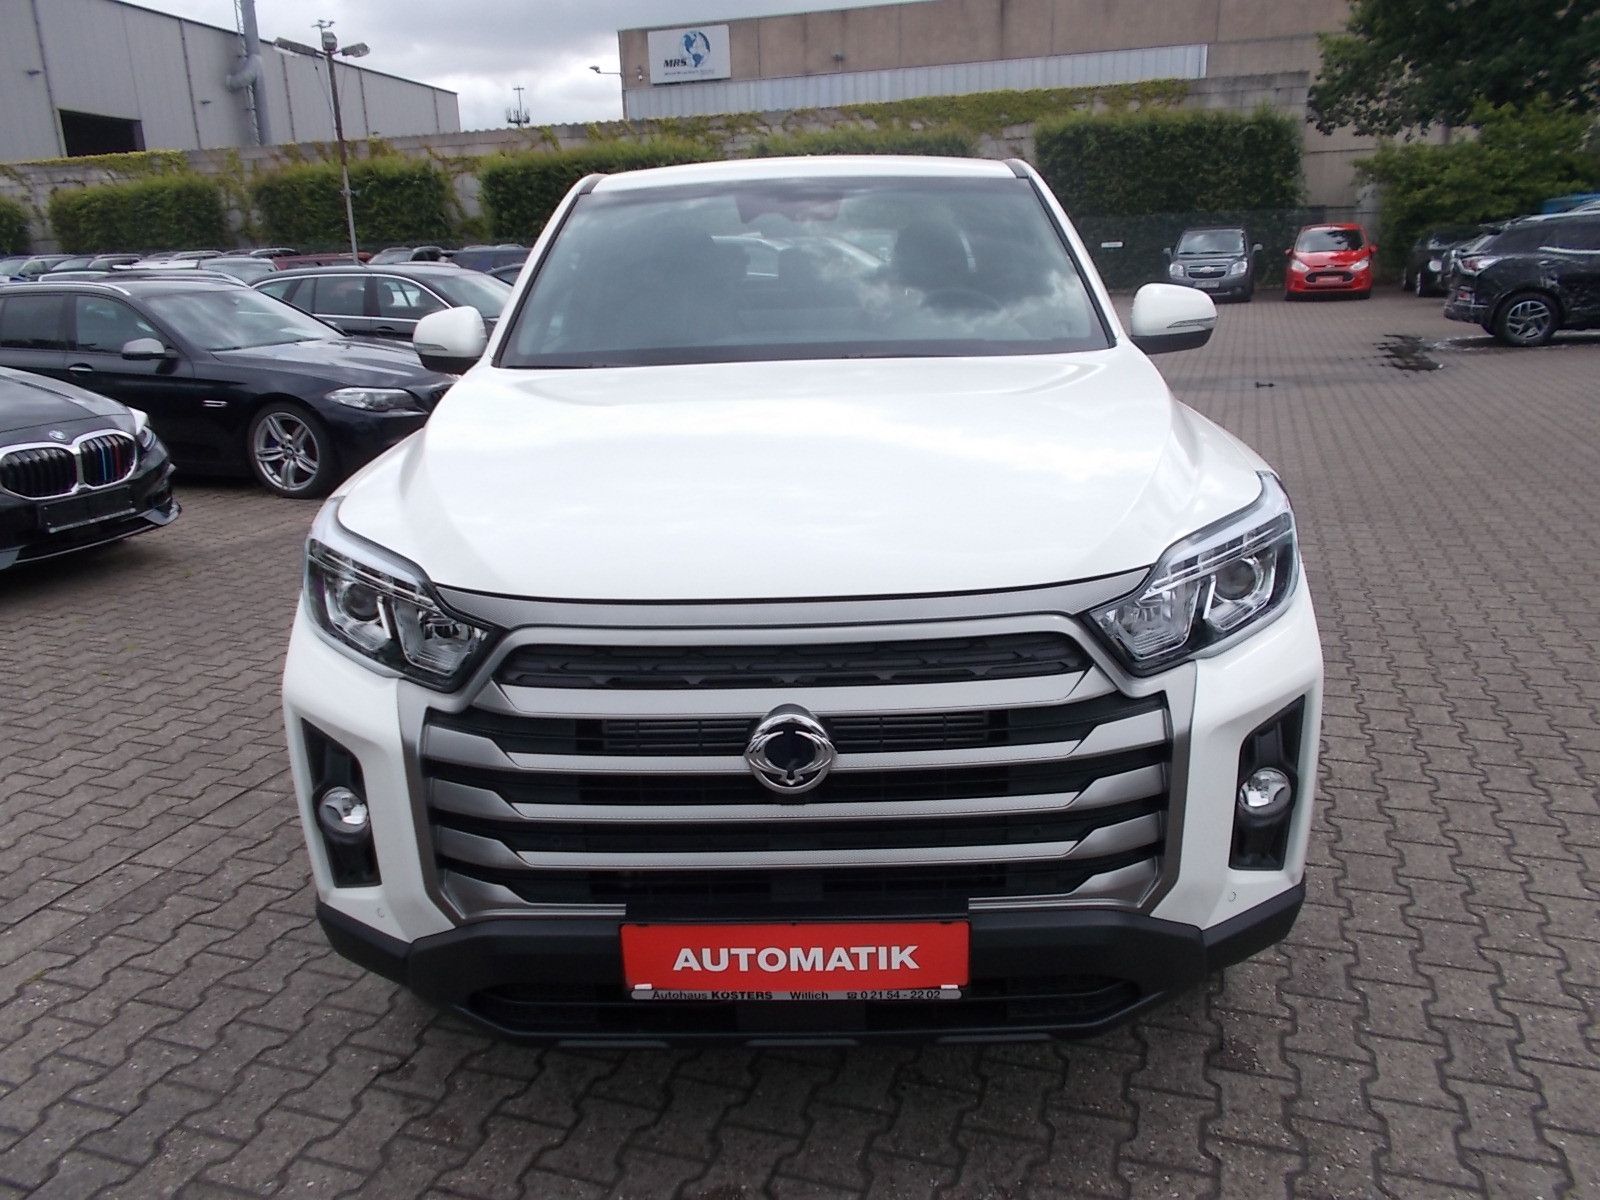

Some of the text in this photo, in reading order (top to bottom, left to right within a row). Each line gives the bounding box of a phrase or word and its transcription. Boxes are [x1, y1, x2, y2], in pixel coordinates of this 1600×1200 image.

[664, 58, 687, 68] MRS
[673, 946, 919, 972] AUTOMATIK
[652, 990, 707, 1000] Autohaus
[790, 991, 828, 1000] Willich
